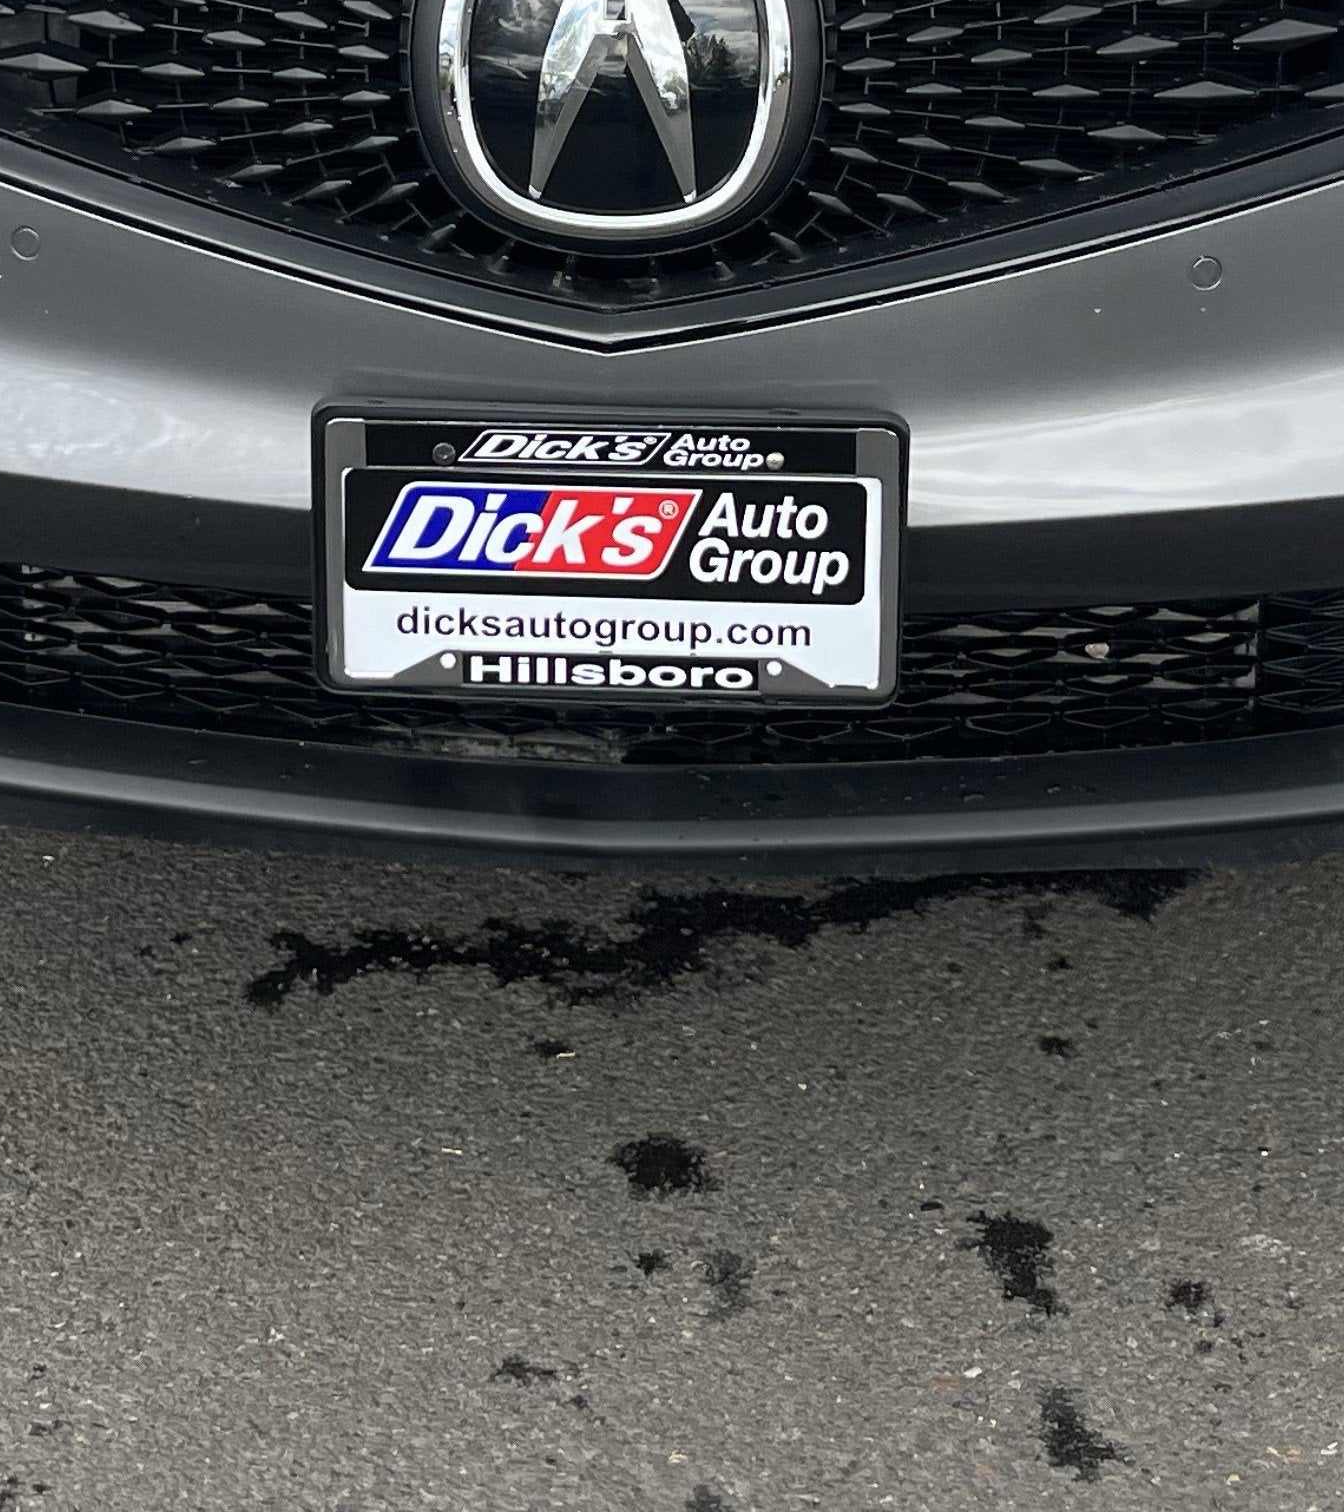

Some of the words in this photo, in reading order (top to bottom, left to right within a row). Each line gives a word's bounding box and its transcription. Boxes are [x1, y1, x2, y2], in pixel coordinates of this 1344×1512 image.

[474, 433, 647, 461] Dick's
[670, 433, 750, 452] Auto
[663, 449, 764, 470] Group
[699, 492, 828, 540] Auto
[688, 539, 850, 595] Group
[397, 606, 812, 648] dicksautogroup.com
[469, 657, 754, 688] Hillsboro
